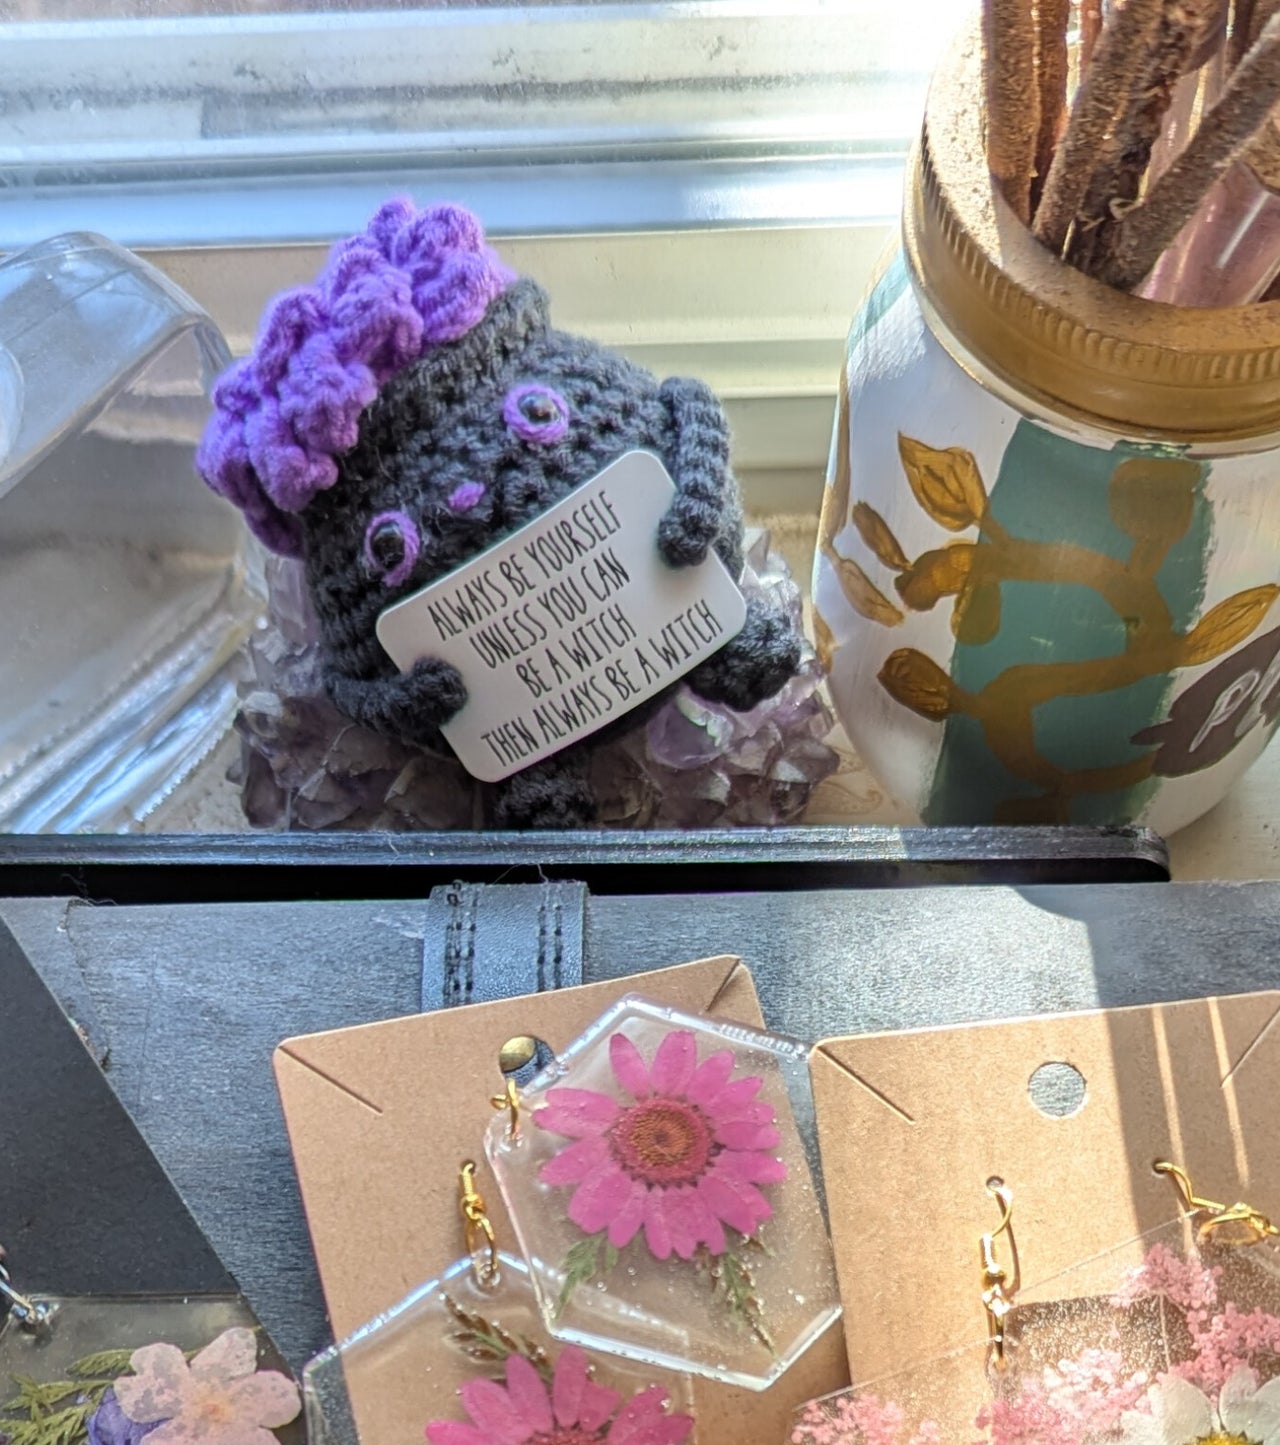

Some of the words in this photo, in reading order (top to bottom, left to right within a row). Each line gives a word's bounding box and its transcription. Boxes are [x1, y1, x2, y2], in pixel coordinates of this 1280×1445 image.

[427, 570, 508, 642] ALWAYS
[499, 553, 536, 598] BE
[524, 490, 622, 579] YOURSELF
[469, 603, 548, 669] UNLESS
[537, 576, 588, 629] YOU
[581, 547, 631, 602] CAN
[481, 716, 540, 767] THEN
[532, 675, 613, 744] ALWAYS
[604, 659, 640, 701] BE
[634, 647, 661, 685] A
[648, 599, 724, 670] WITCH
[515, 658, 552, 698] BE
[545, 647, 572, 685] A
[558, 603, 637, 672] WITCH
